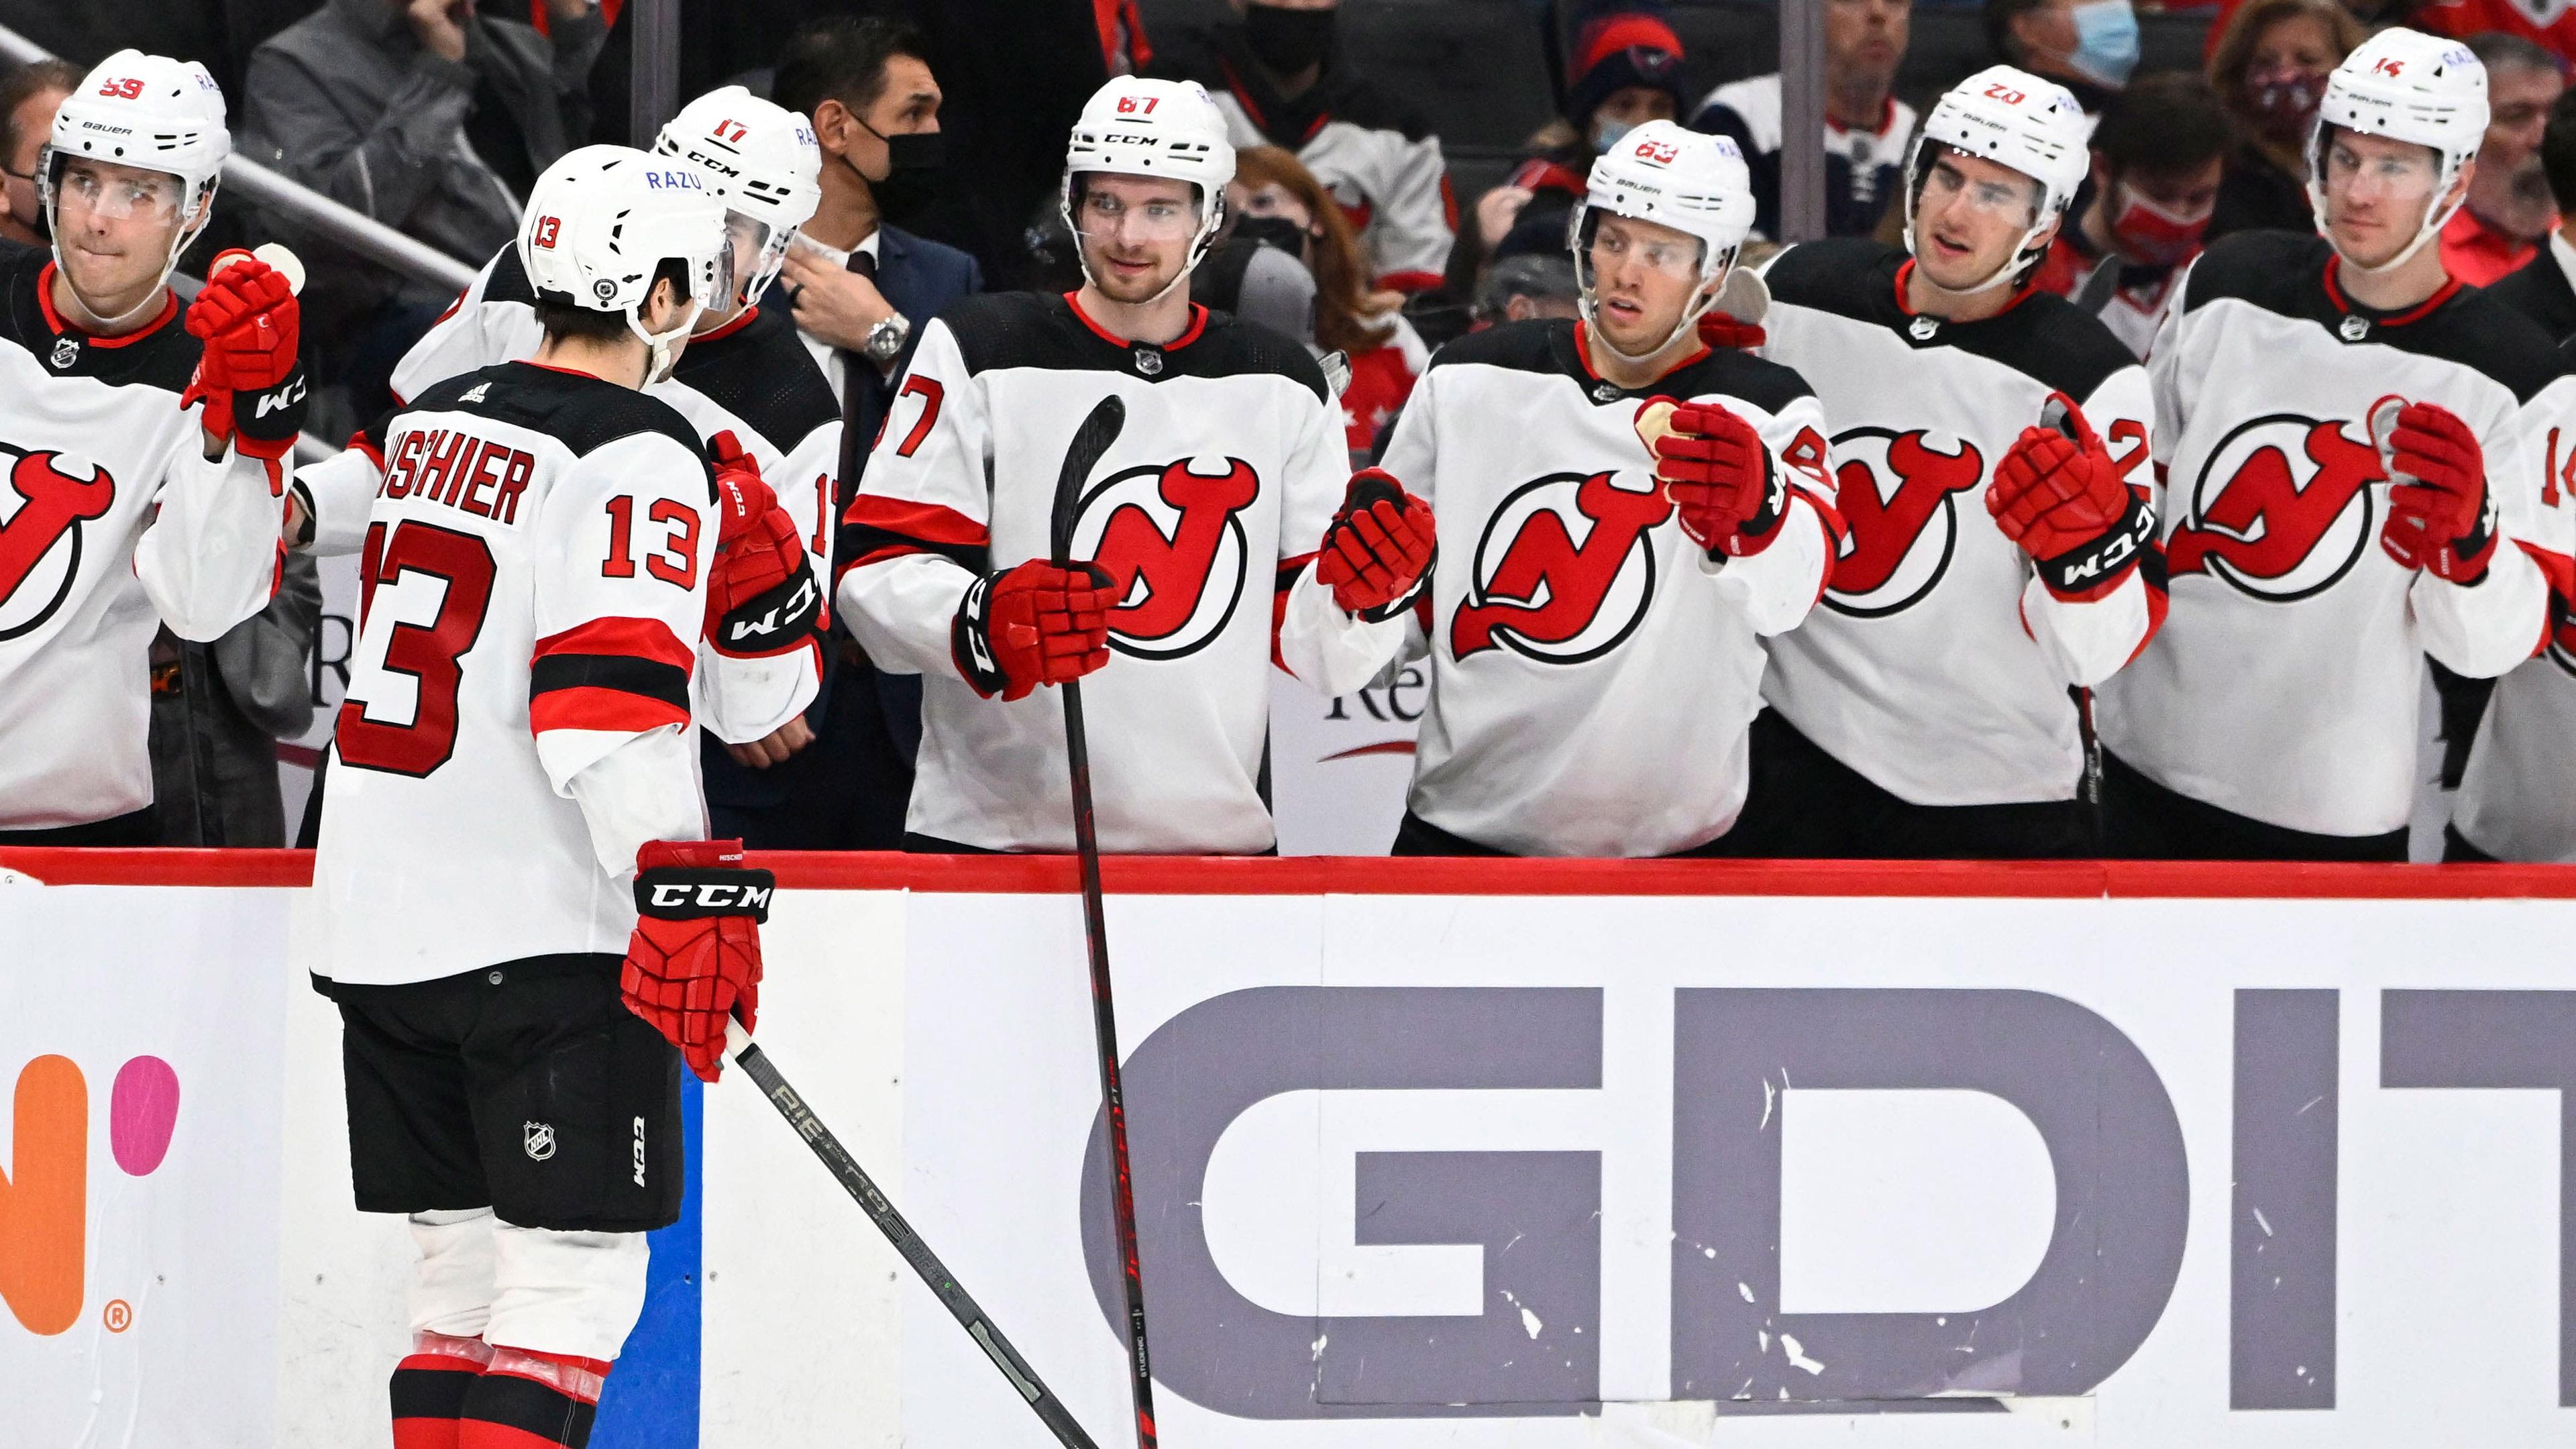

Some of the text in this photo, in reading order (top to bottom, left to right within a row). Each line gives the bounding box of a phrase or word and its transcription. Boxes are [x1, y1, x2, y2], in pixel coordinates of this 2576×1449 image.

[99, 78, 146, 99] 59
[1984, 83, 2025, 105] 20
[1117, 97, 1161, 115] 67
[82, 121, 133, 136] BAUER
[713, 119, 750, 143] 17
[1104, 133, 1159, 146] CCM
[688, 150, 740, 178] CCM
[1635, 141, 1678, 164] 63
[645, 171, 702, 191] RAZU
[534, 215, 561, 249] 13
[810, 472, 839, 559] 1
[601, 494, 702, 593] 13
[2064, 505, 2156, 586] CCM
[730, 576, 818, 641] CM
[334, 519, 498, 781] 13
[649, 884, 771, 910] CCM
[529, 1131, 549, 1151] NHL
[633, 1116, 645, 1187] CCM
